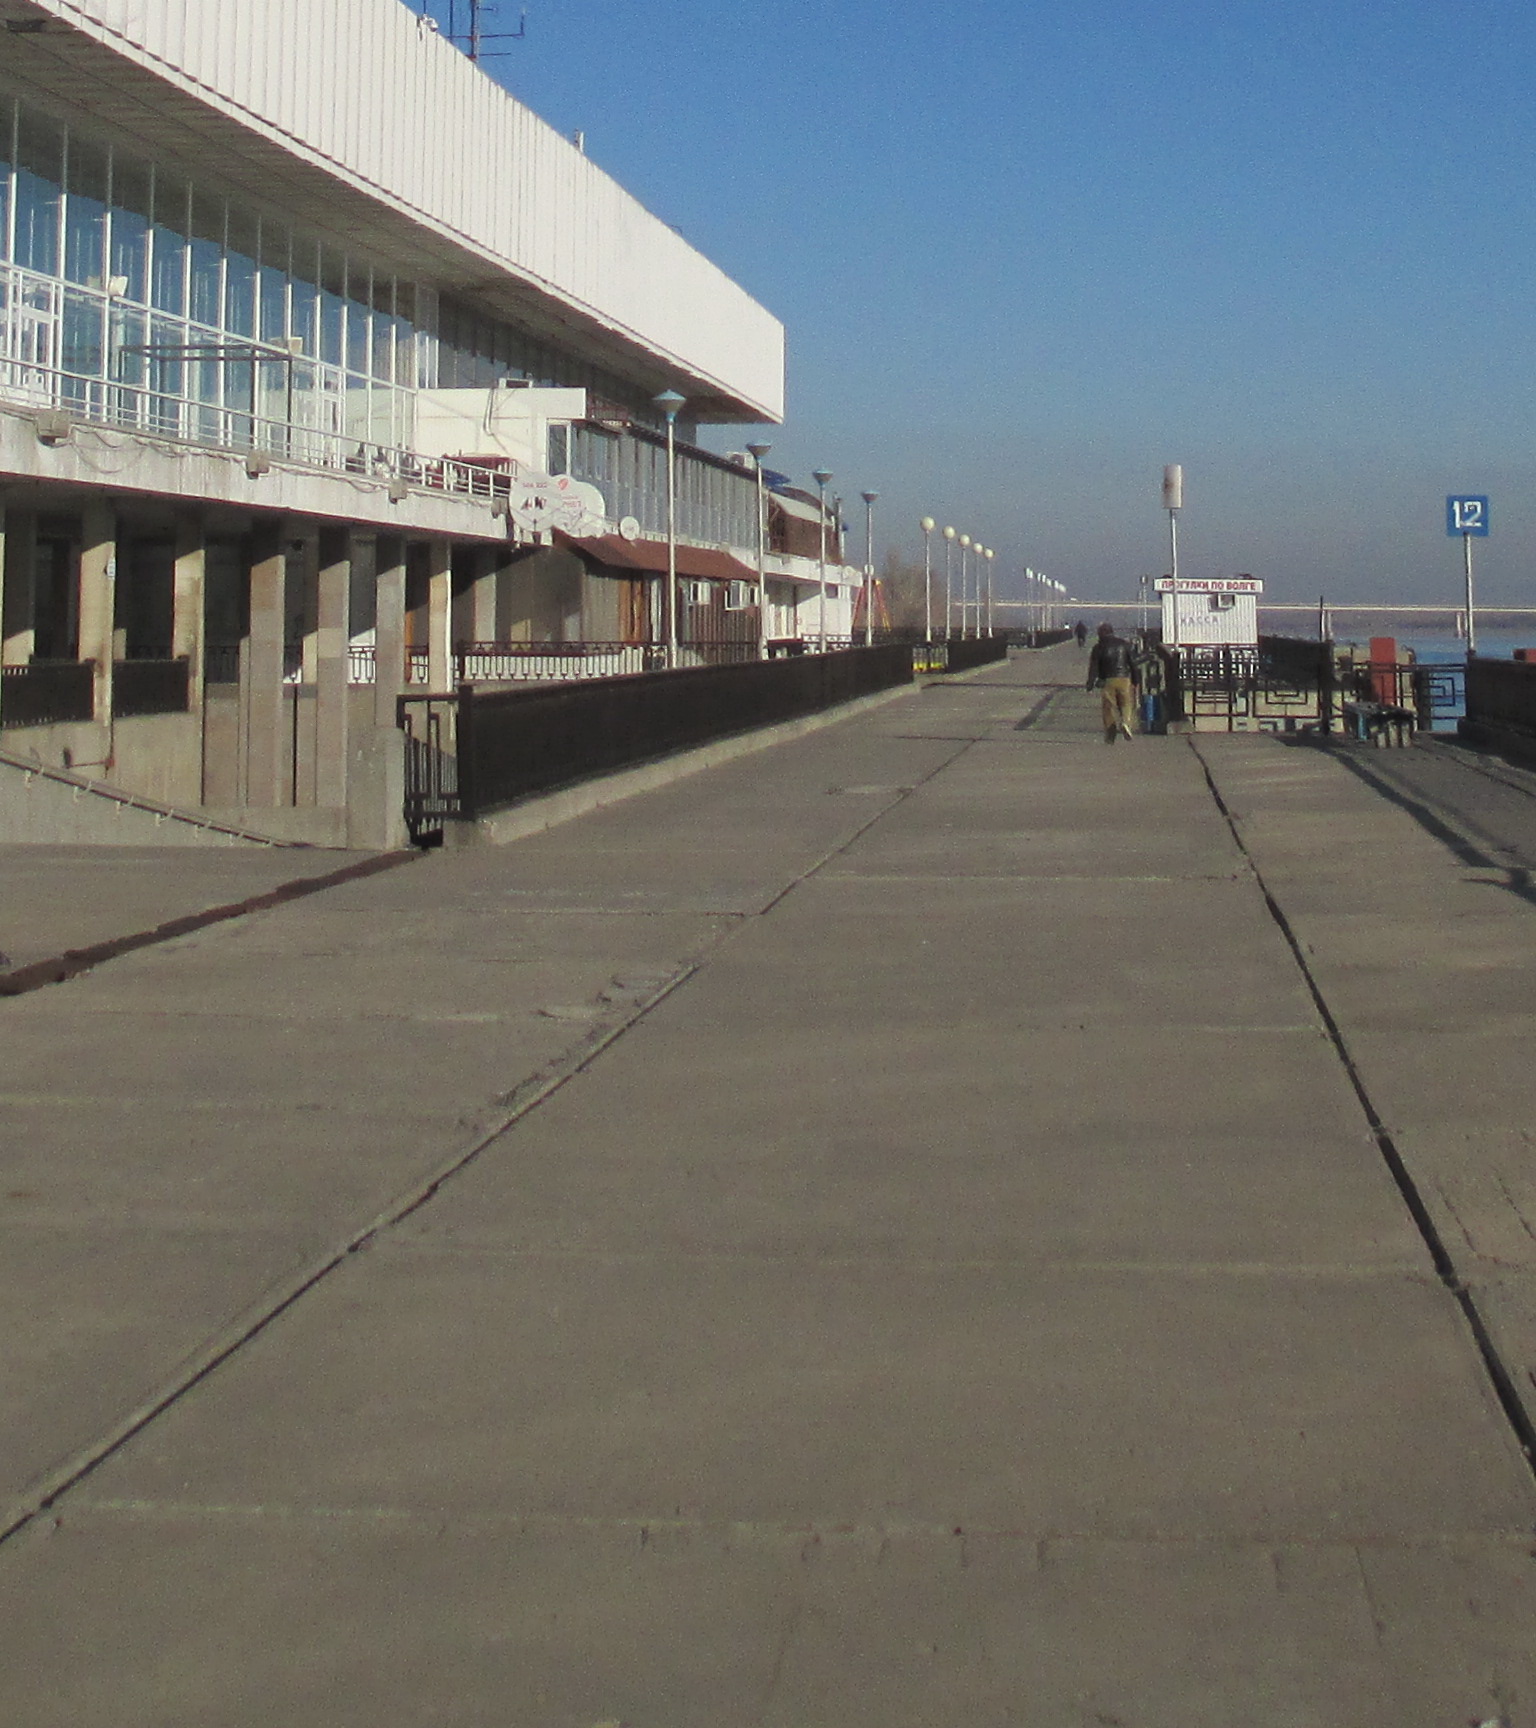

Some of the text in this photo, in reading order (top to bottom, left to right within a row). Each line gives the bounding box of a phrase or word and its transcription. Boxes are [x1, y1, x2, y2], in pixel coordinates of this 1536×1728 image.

[1453, 500, 1482, 528] 12
[1211, 581, 1224, 591] ПО
[1226, 582, 1256, 591] ВОЛГЕ
[1181, 617, 1219, 626] КАССА
